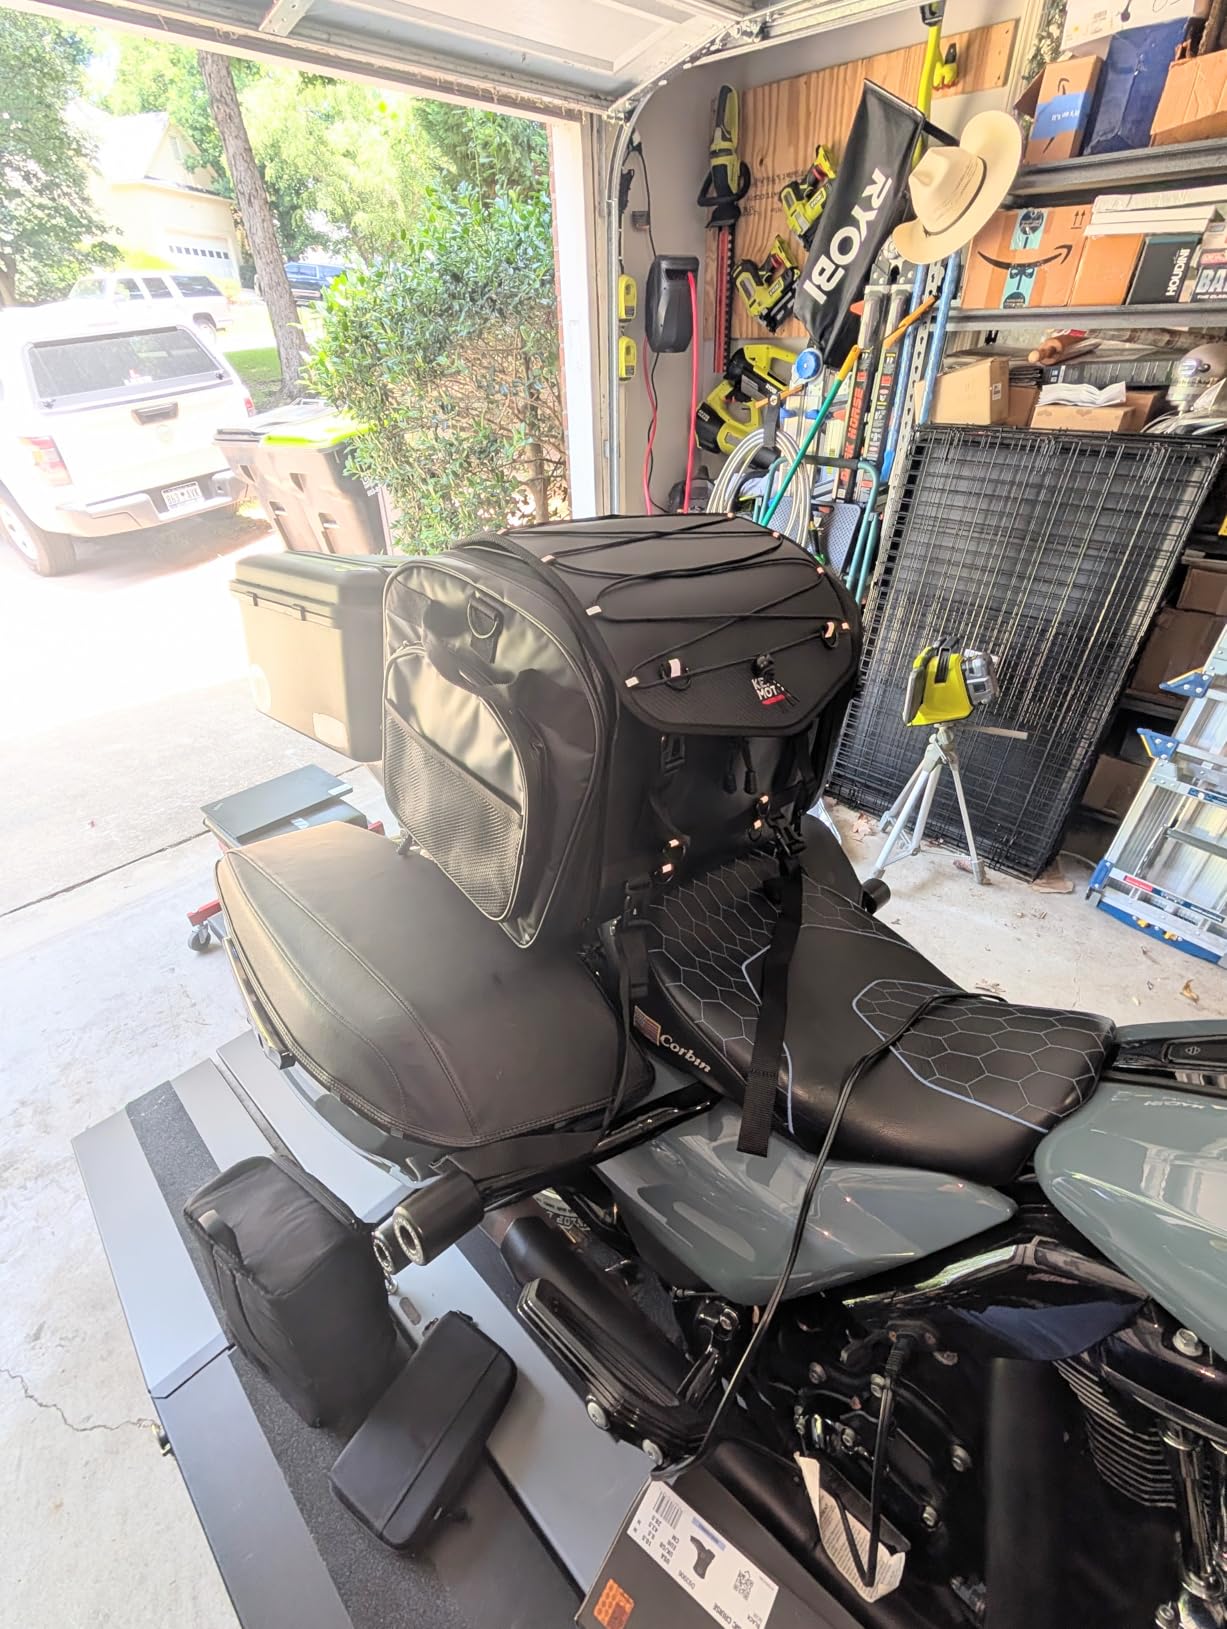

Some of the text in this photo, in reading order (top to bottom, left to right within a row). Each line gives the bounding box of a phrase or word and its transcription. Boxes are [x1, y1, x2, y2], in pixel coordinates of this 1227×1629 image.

[803, 167, 893, 305] RYOBI
[1165, 248, 1191, 296] HOUDINI
[1196, 269, 1227, 293] BA
[840, 386, 864, 481] DRK HORSE
[757, 685, 780, 700] MOT
[660, 1035, 711, 1072] Corbin
[659, 1541, 673, 1558] UK/GB
[667, 1539, 677, 1551] EUR
[671, 1534, 680, 1544] CM
[661, 1553, 671, 1565] USA
[713, 1602, 732, 1625] CRUISE
